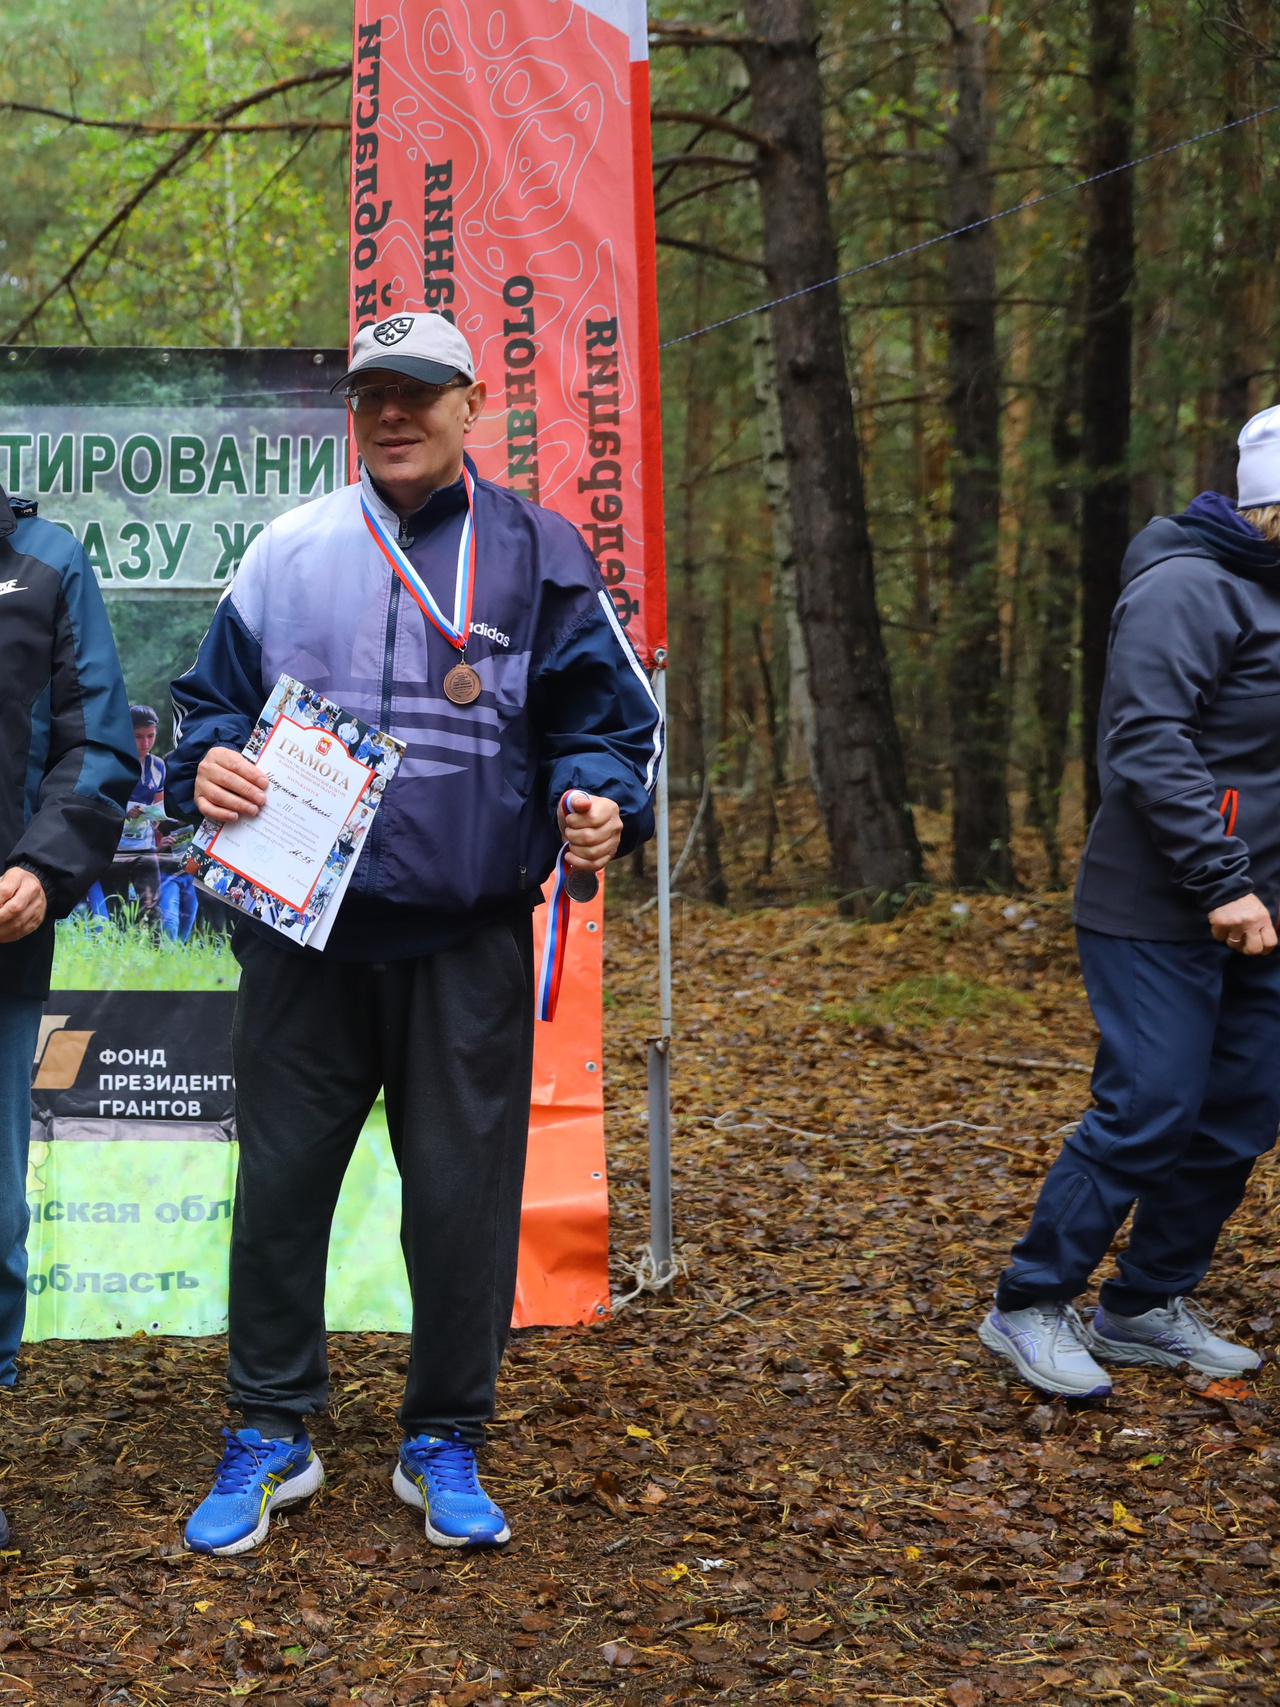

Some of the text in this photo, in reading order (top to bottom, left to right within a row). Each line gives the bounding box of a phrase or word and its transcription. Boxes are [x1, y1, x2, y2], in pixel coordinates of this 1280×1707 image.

[277, 737, 350, 791] ГРАМОТА
[99, 1048, 167, 1068] ФОНД
[99, 1074, 236, 1094] ПРЕЗИДЕНТ
[99, 1100, 202, 1117] ГРАНТОВ
[27, 1263, 200, 1296] область
